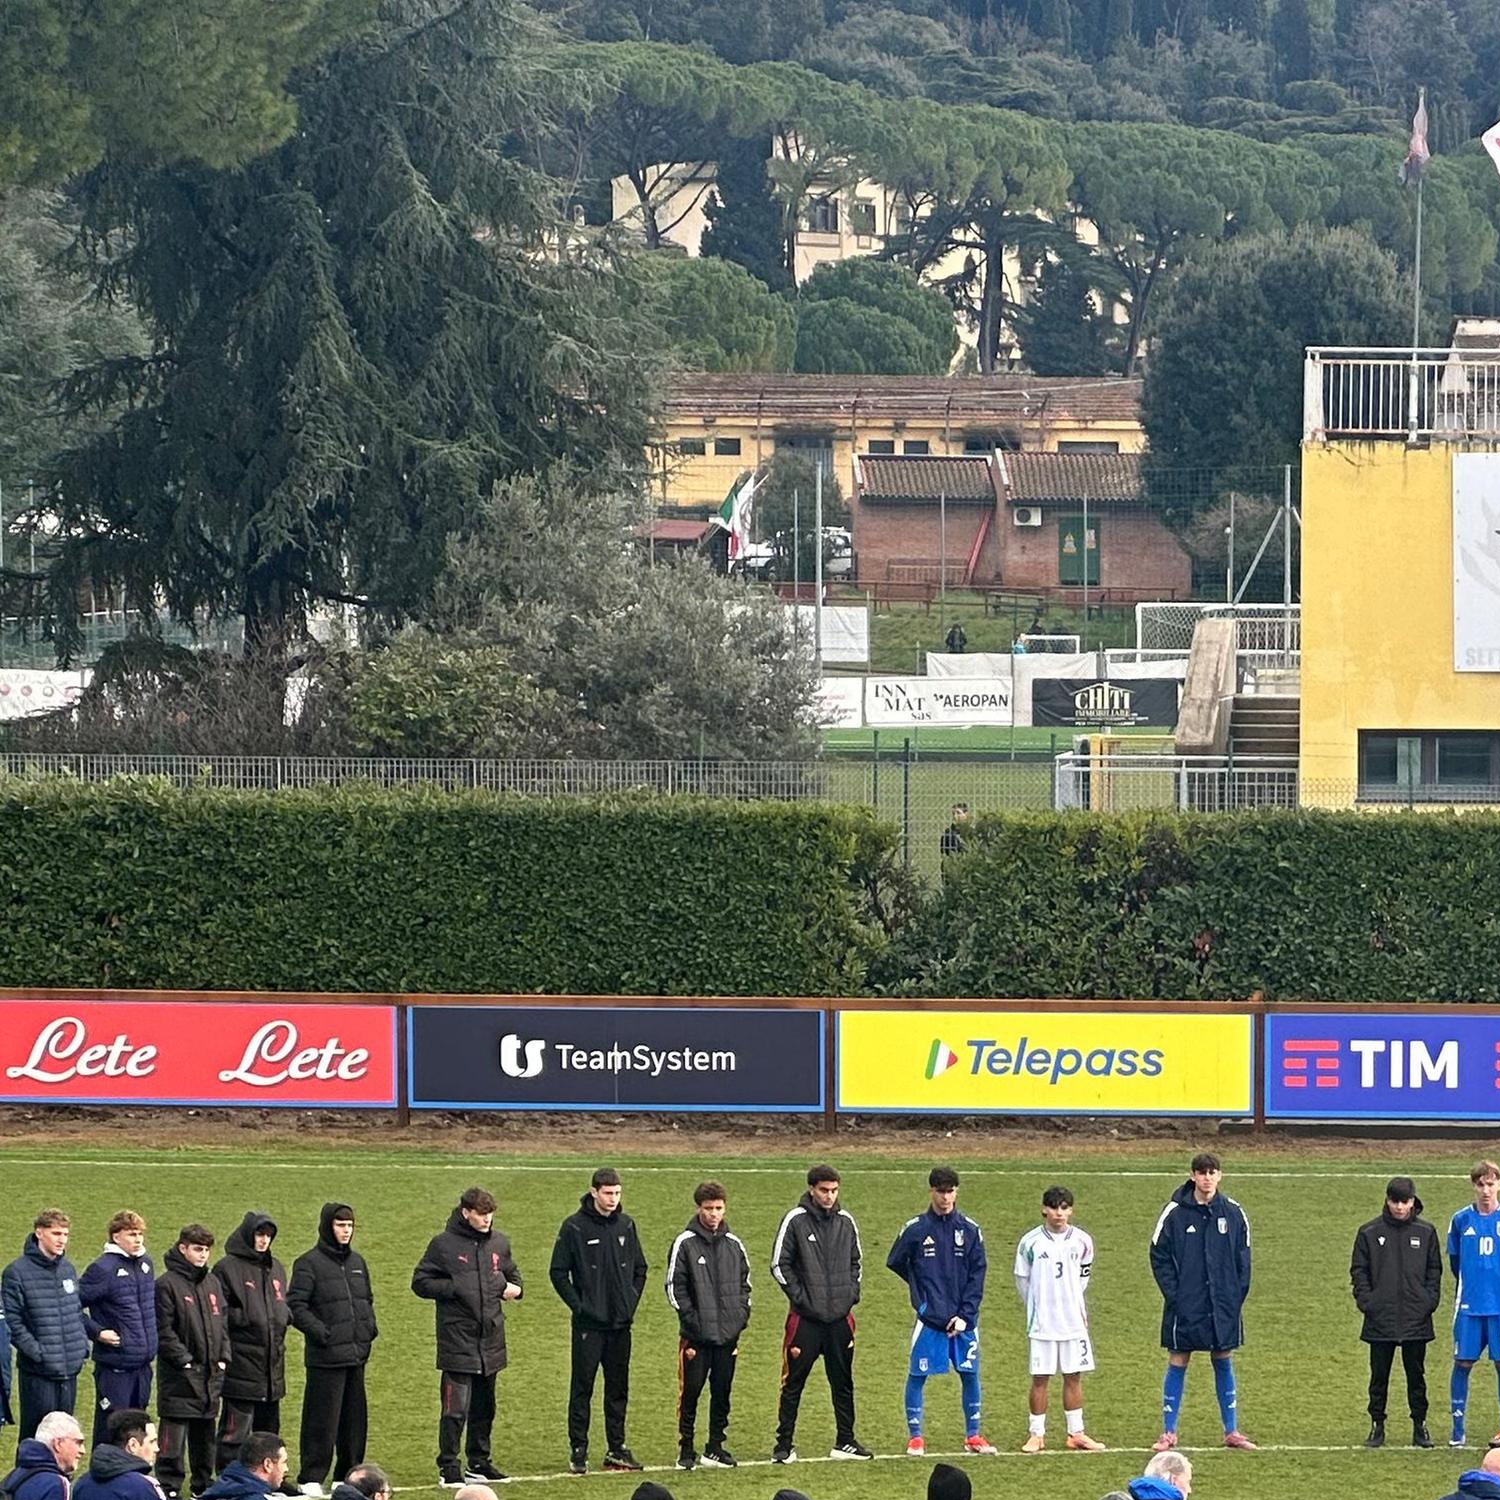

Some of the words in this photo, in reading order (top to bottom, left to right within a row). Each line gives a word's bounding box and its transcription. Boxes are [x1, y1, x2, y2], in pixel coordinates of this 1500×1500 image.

[874, 684, 907, 698] INN
[942, 693, 1009, 708] AEROPAN
[1074, 682, 1130, 710] CHITI
[884, 698, 926, 712] MAT
[6, 1016, 158, 1080] Lete
[218, 1019, 369, 1087] Lete
[555, 1043, 736, 1076] TeamSystem
[966, 1037, 1165, 1085] Telepass
[1349, 1039, 1459, 1089] TIM
[1479, 1236, 1494, 1256] 10
[1055, 1262, 1063, 1279] 3
[966, 1340, 978, 1360] 2
[1079, 1339, 1088, 1357] 3
